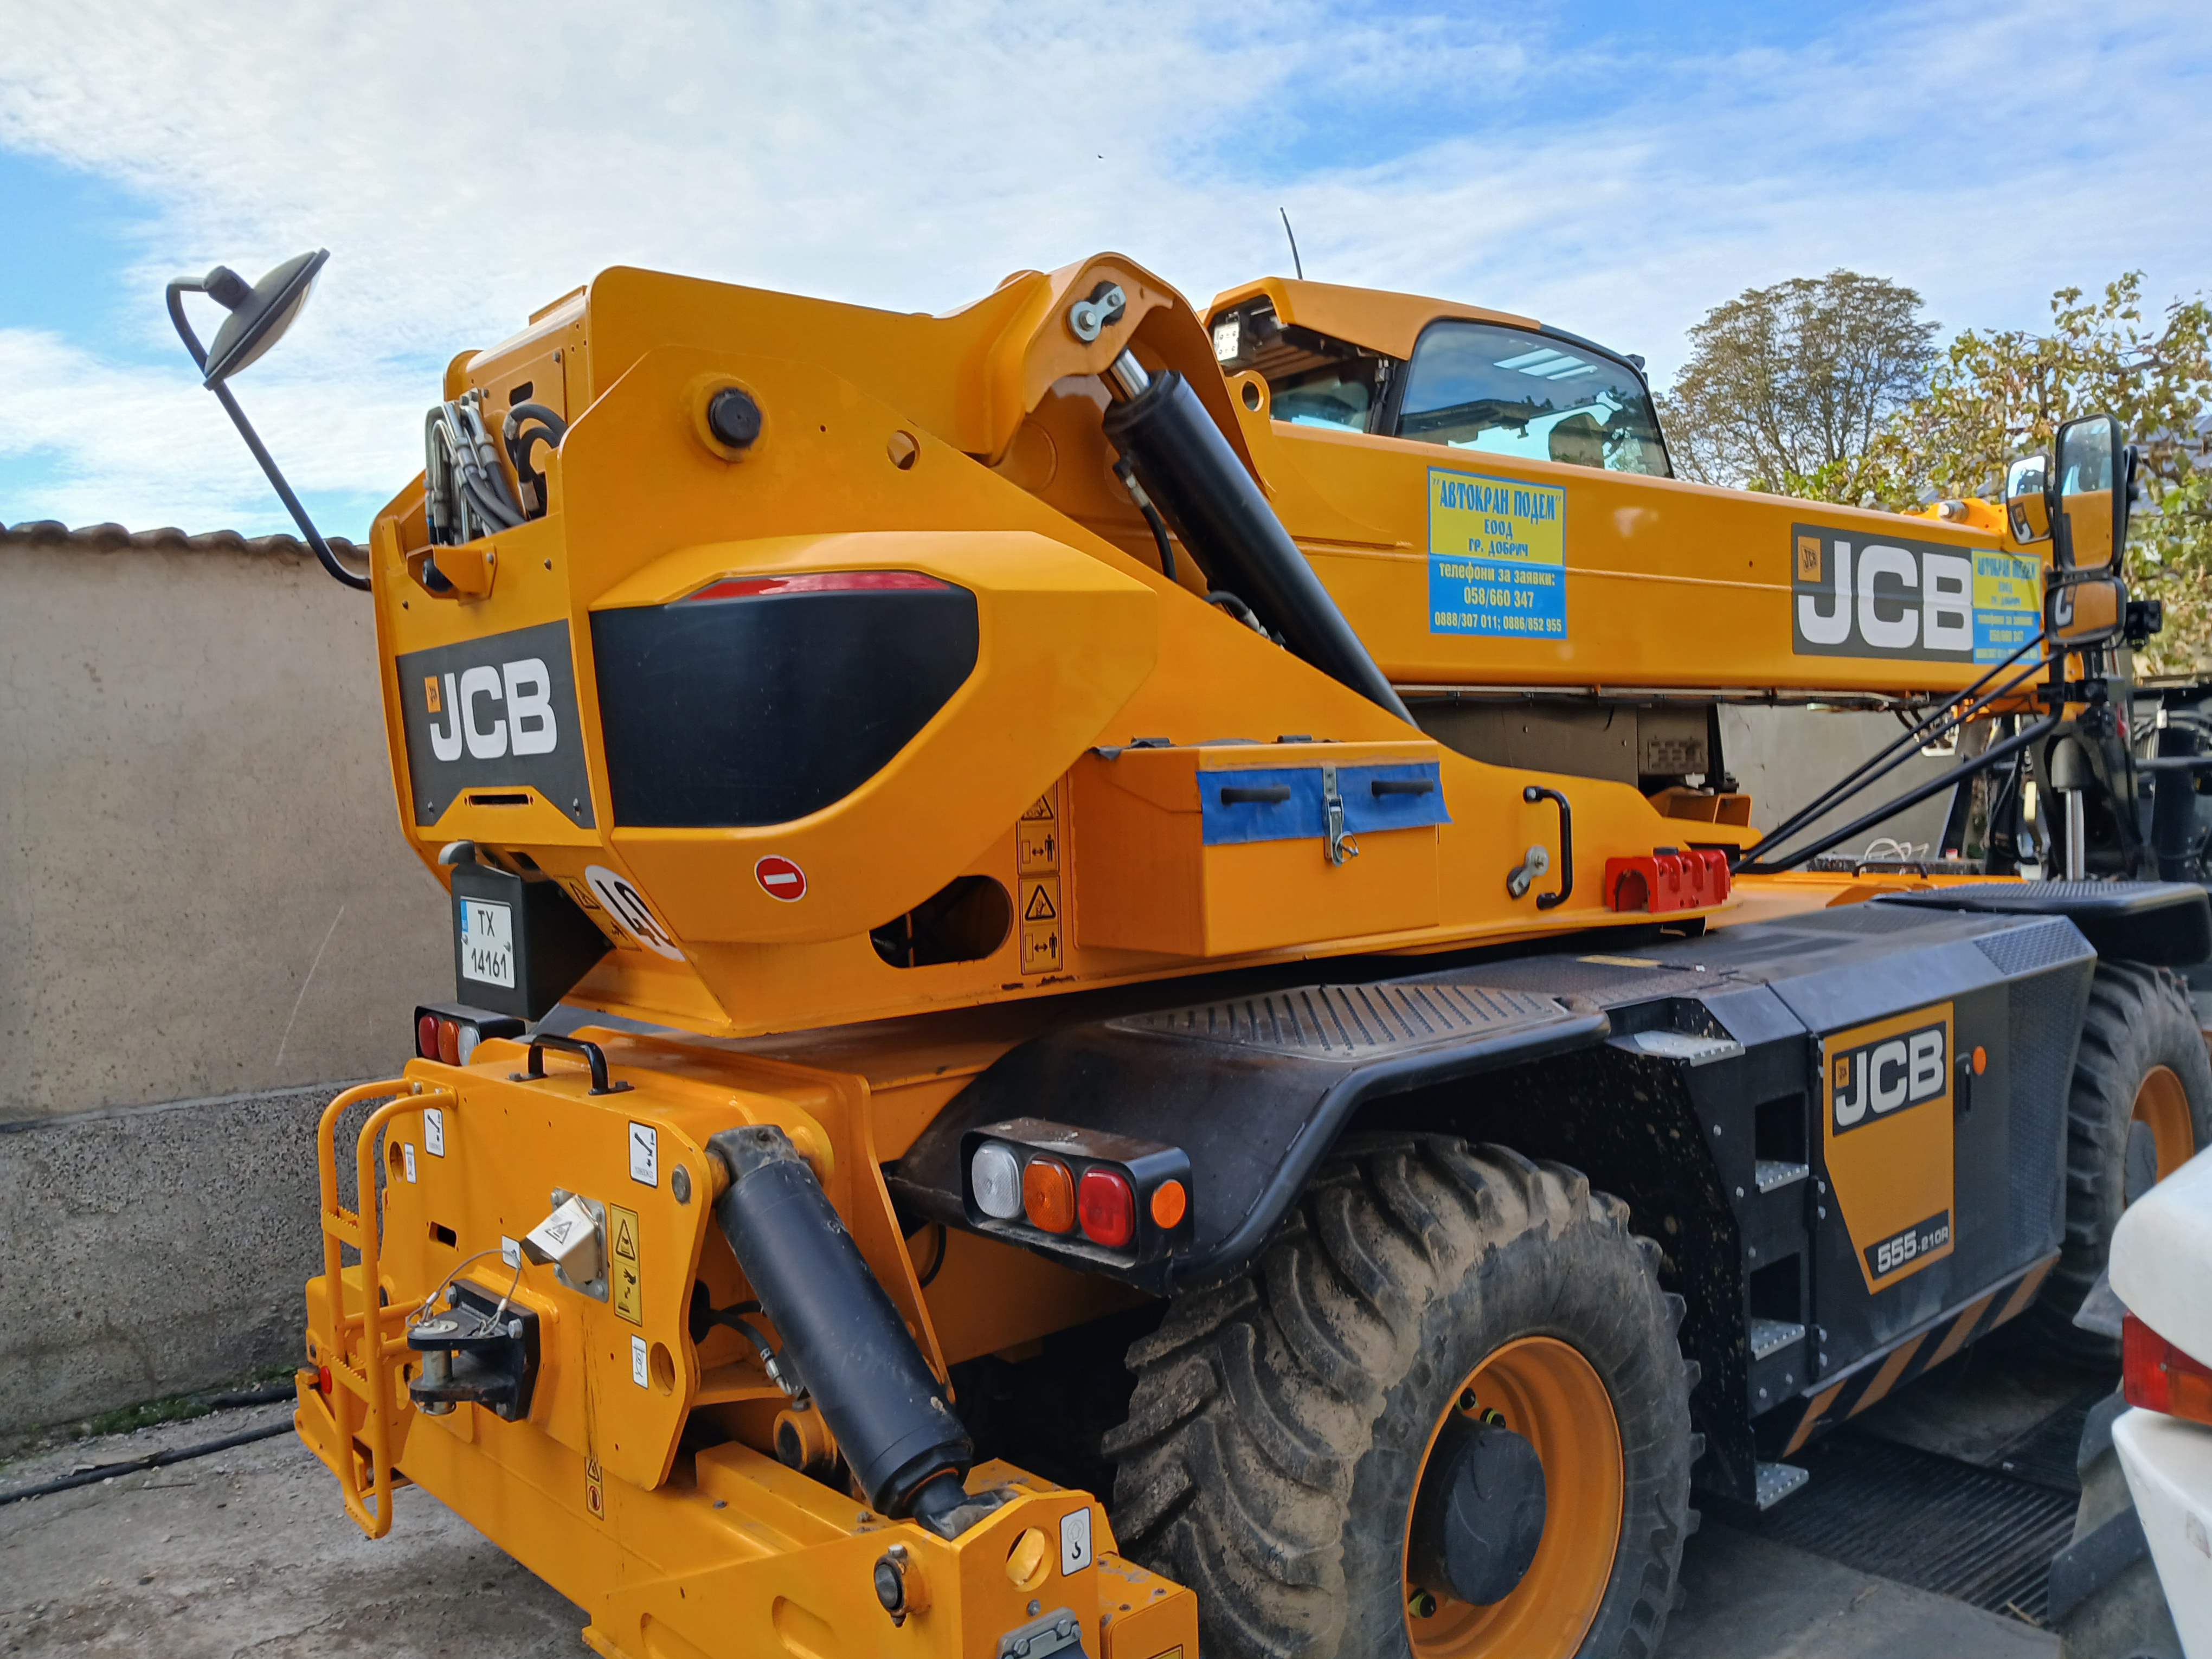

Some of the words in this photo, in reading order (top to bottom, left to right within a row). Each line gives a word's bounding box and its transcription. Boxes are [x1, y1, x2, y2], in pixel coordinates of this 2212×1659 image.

[1484, 518, 1513, 540] ЕООД
[1469, 538, 1484, 553] ГР.
[1488, 540, 1528, 557] ДОБРИЧ
[1439, 561, 1495, 583] телефони
[1498, 569, 1511, 583] за
[1464, 586, 1511, 608] 058/660
[1514, 590, 1534, 608] 347
[1798, 540, 1974, 651] JCB
[1434, 611, 1478, 629] 0888/307
[1481, 614, 1501, 631] 011;
[1503, 615, 1545, 633] 0886/852
[1546, 618, 1562, 632] 955
[430, 658, 558, 761] JCB
[478, 909, 496, 937] TX
[471, 947, 507, 980] 14161
[1836, 1030, 1944, 1127] JCB
